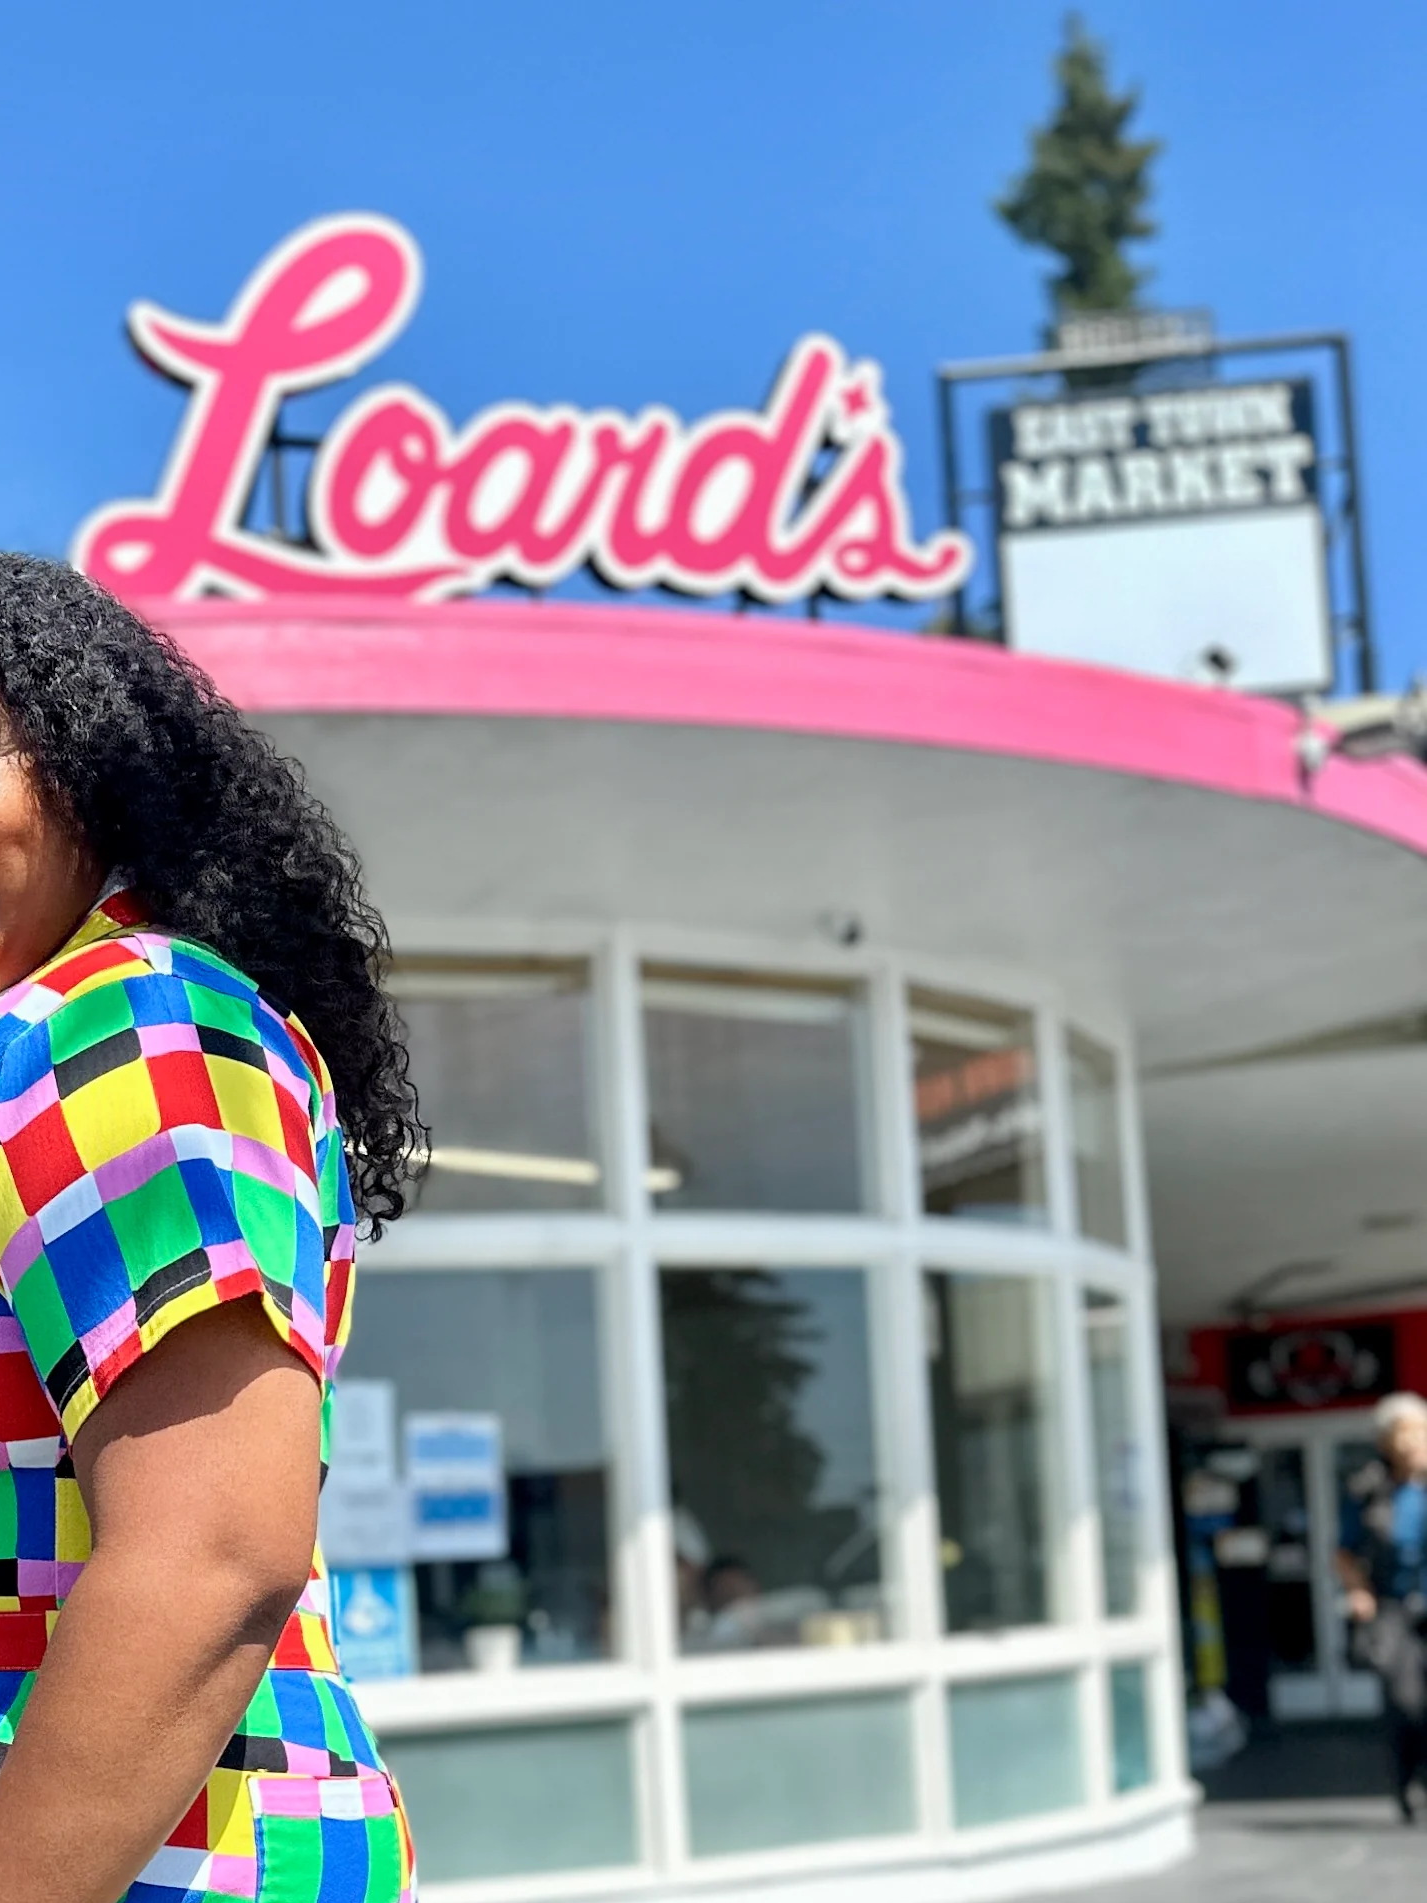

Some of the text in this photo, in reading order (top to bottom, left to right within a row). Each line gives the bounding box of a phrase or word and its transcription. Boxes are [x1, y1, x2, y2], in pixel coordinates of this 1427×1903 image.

[75, 216, 969, 600] Loard's
[1013, 383, 1293, 458] EAST TOWN
[1000, 430, 1314, 527] MARKET
